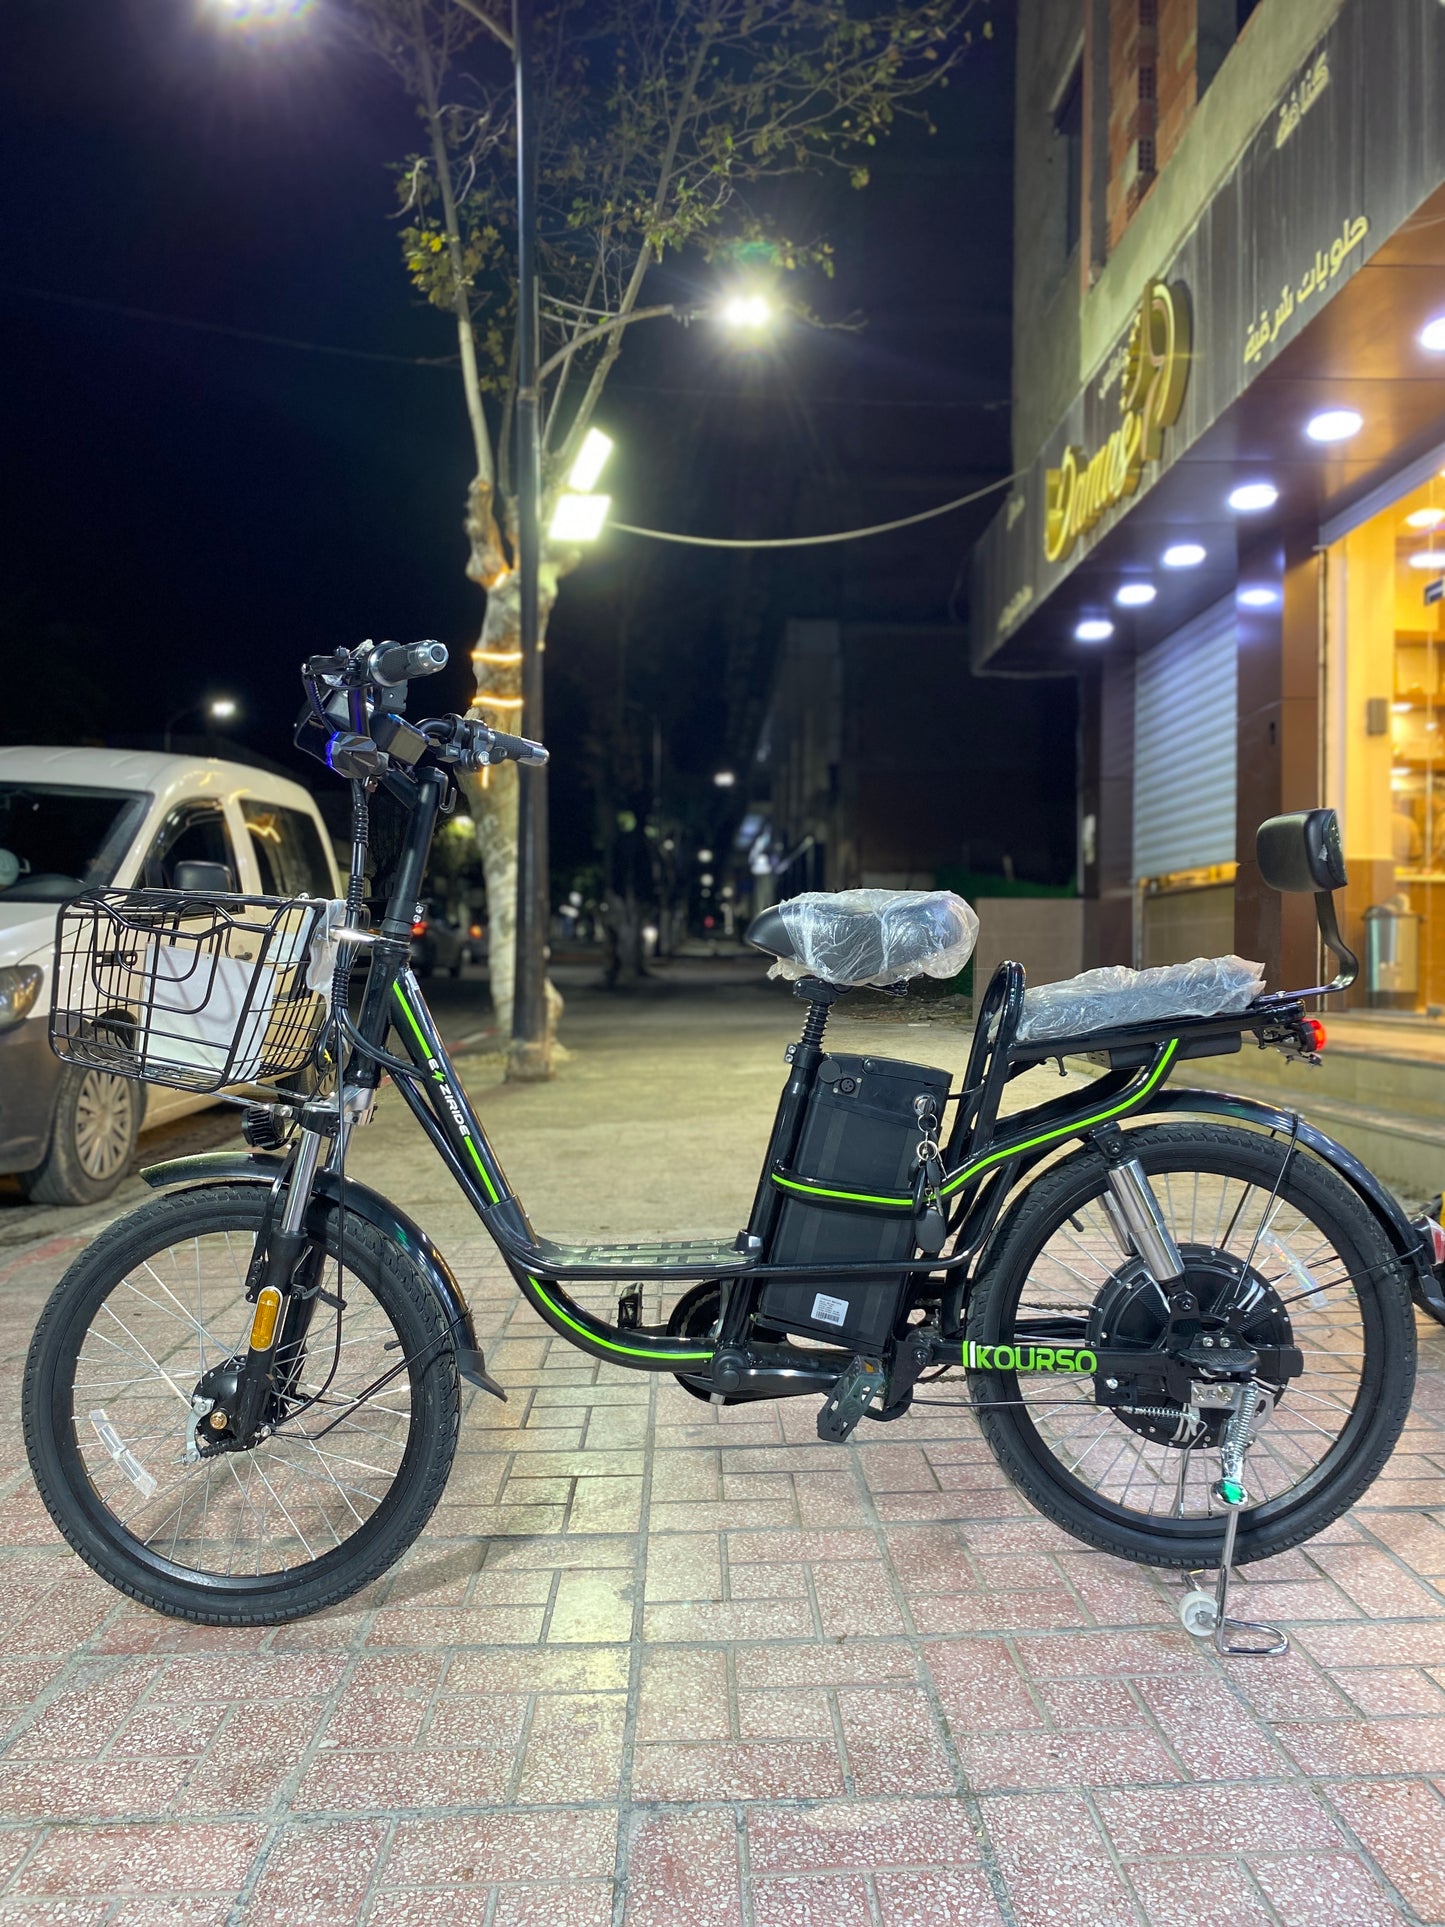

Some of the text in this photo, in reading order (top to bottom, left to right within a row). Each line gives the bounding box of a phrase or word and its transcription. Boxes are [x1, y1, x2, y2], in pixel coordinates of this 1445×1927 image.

[1275, 51, 1330, 149] كنافة
[1244, 216, 1368, 364] حلويات شرقية
[976, 1344, 1098, 1373] KOURSO
